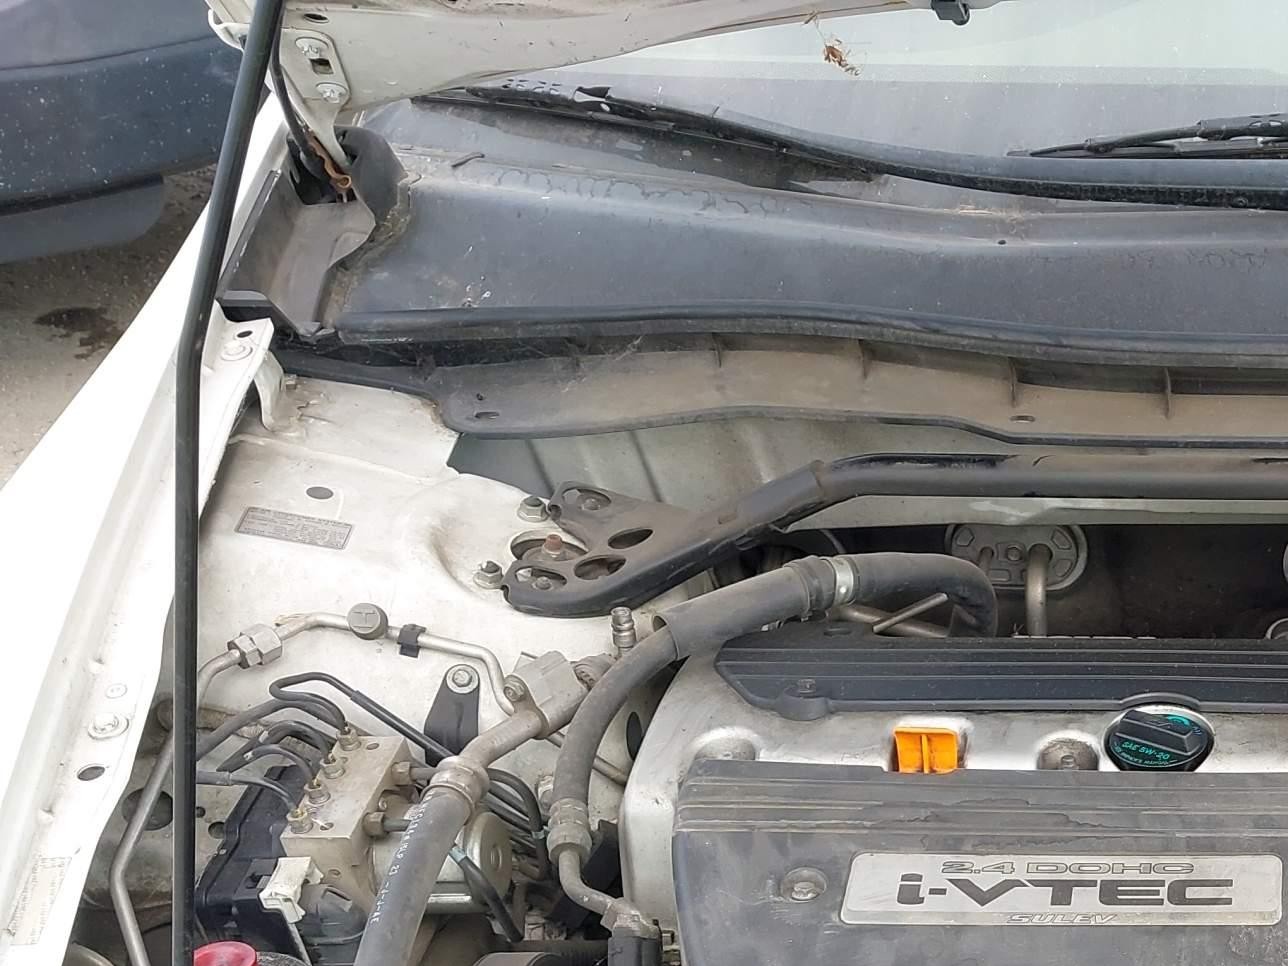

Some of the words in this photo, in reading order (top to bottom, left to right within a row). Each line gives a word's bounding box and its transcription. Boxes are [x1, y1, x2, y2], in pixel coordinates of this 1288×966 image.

[1121, 741, 1140, 751] SAE
[1138, 746, 1171, 760] 5W-20
[941, 861, 1016, 875] 2.4
[1025, 861, 1195, 875] DOHC
[896, 873, 1234, 907] i-VTEC
[1006, 912, 1117, 925] SULEV
